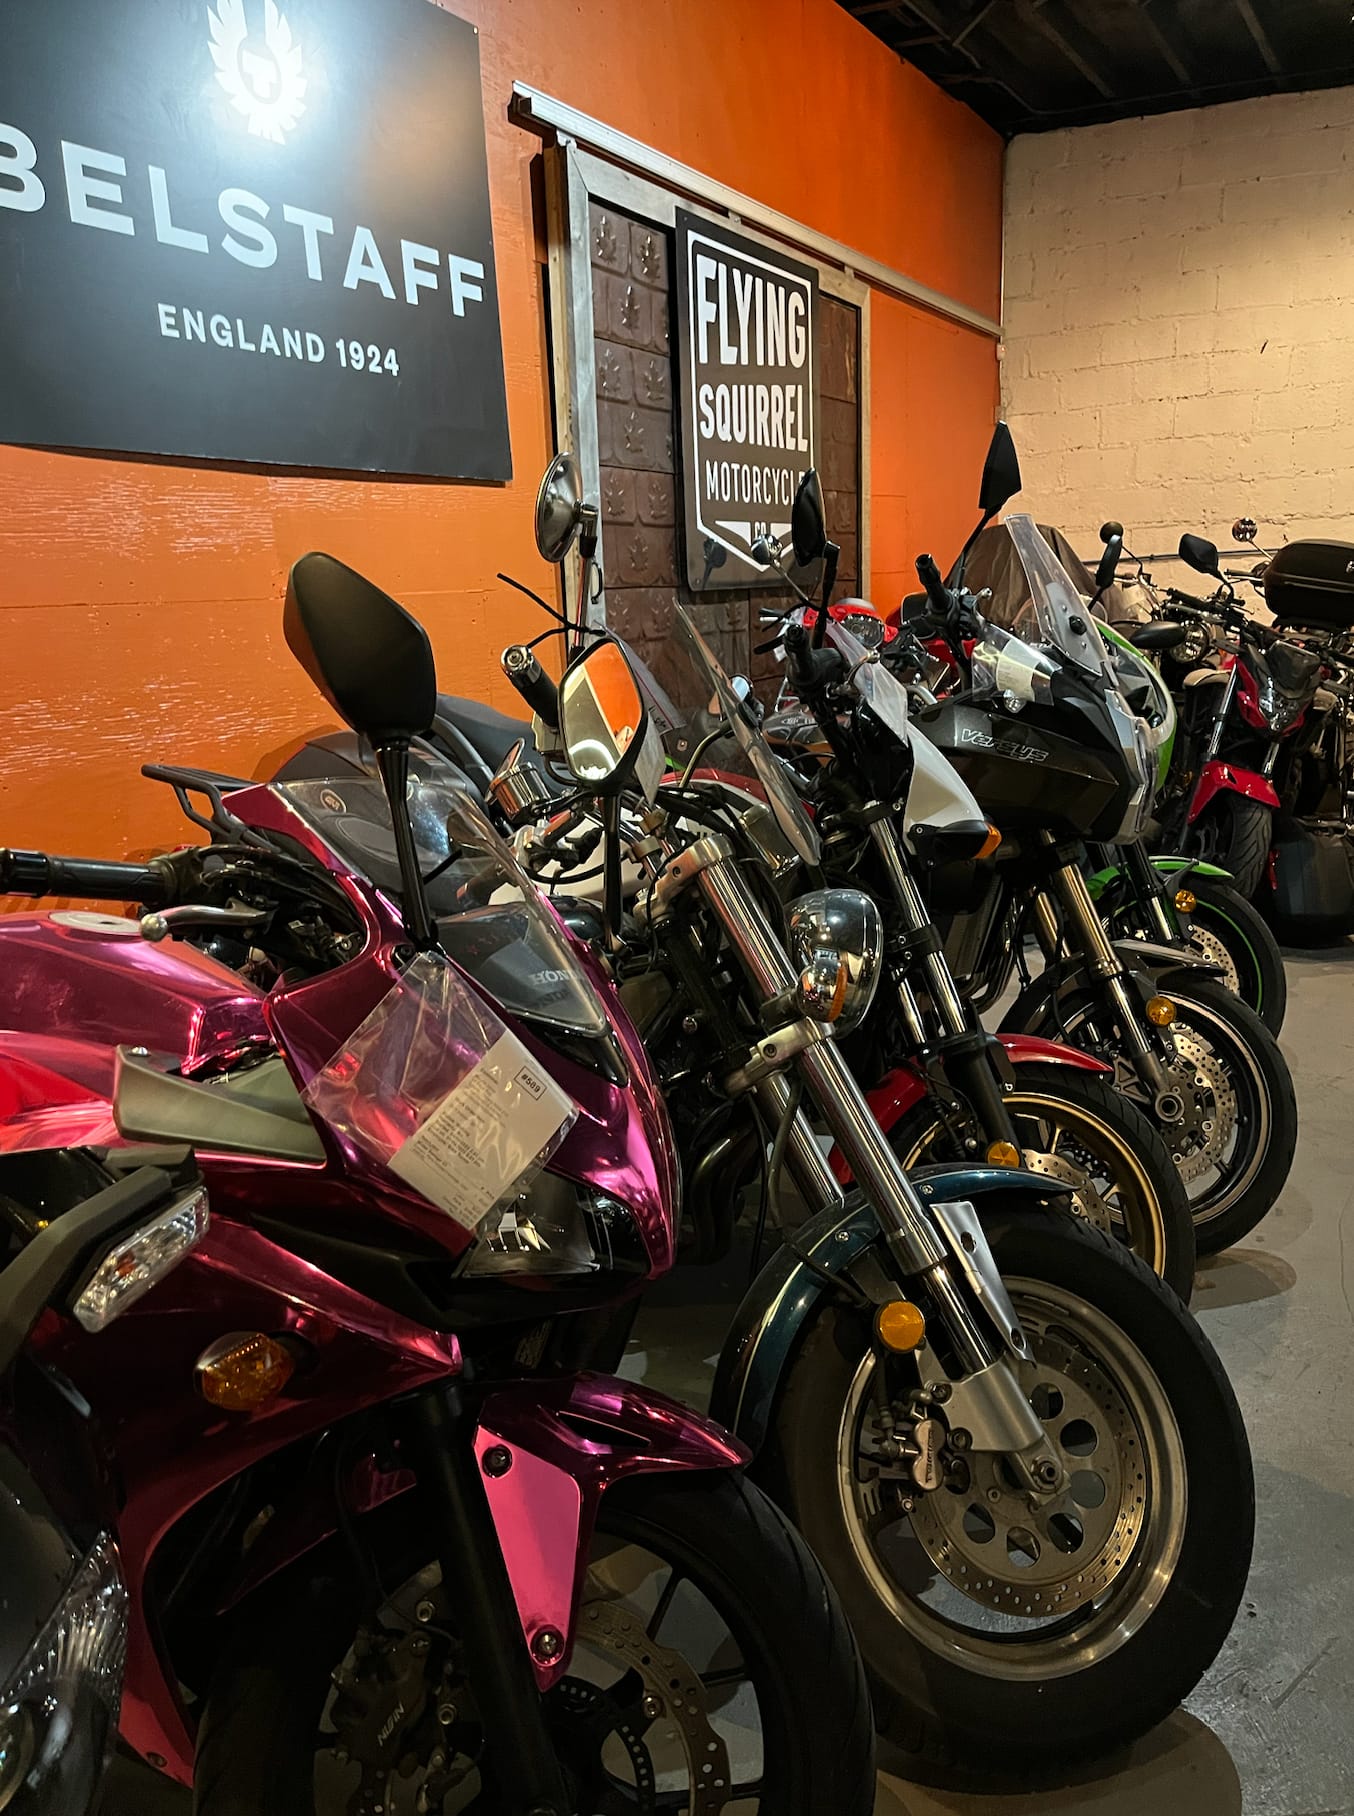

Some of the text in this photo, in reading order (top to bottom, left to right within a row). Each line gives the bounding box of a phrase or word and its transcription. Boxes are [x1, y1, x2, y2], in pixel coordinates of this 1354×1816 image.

[0, 122, 485, 318] BELSTAFF
[157, 302, 400, 377] ENGLAND 1924
[696, 253, 807, 369] FLYING
[699, 383, 808, 452] SQUIRREL
[529, 968, 573, 986] HON
